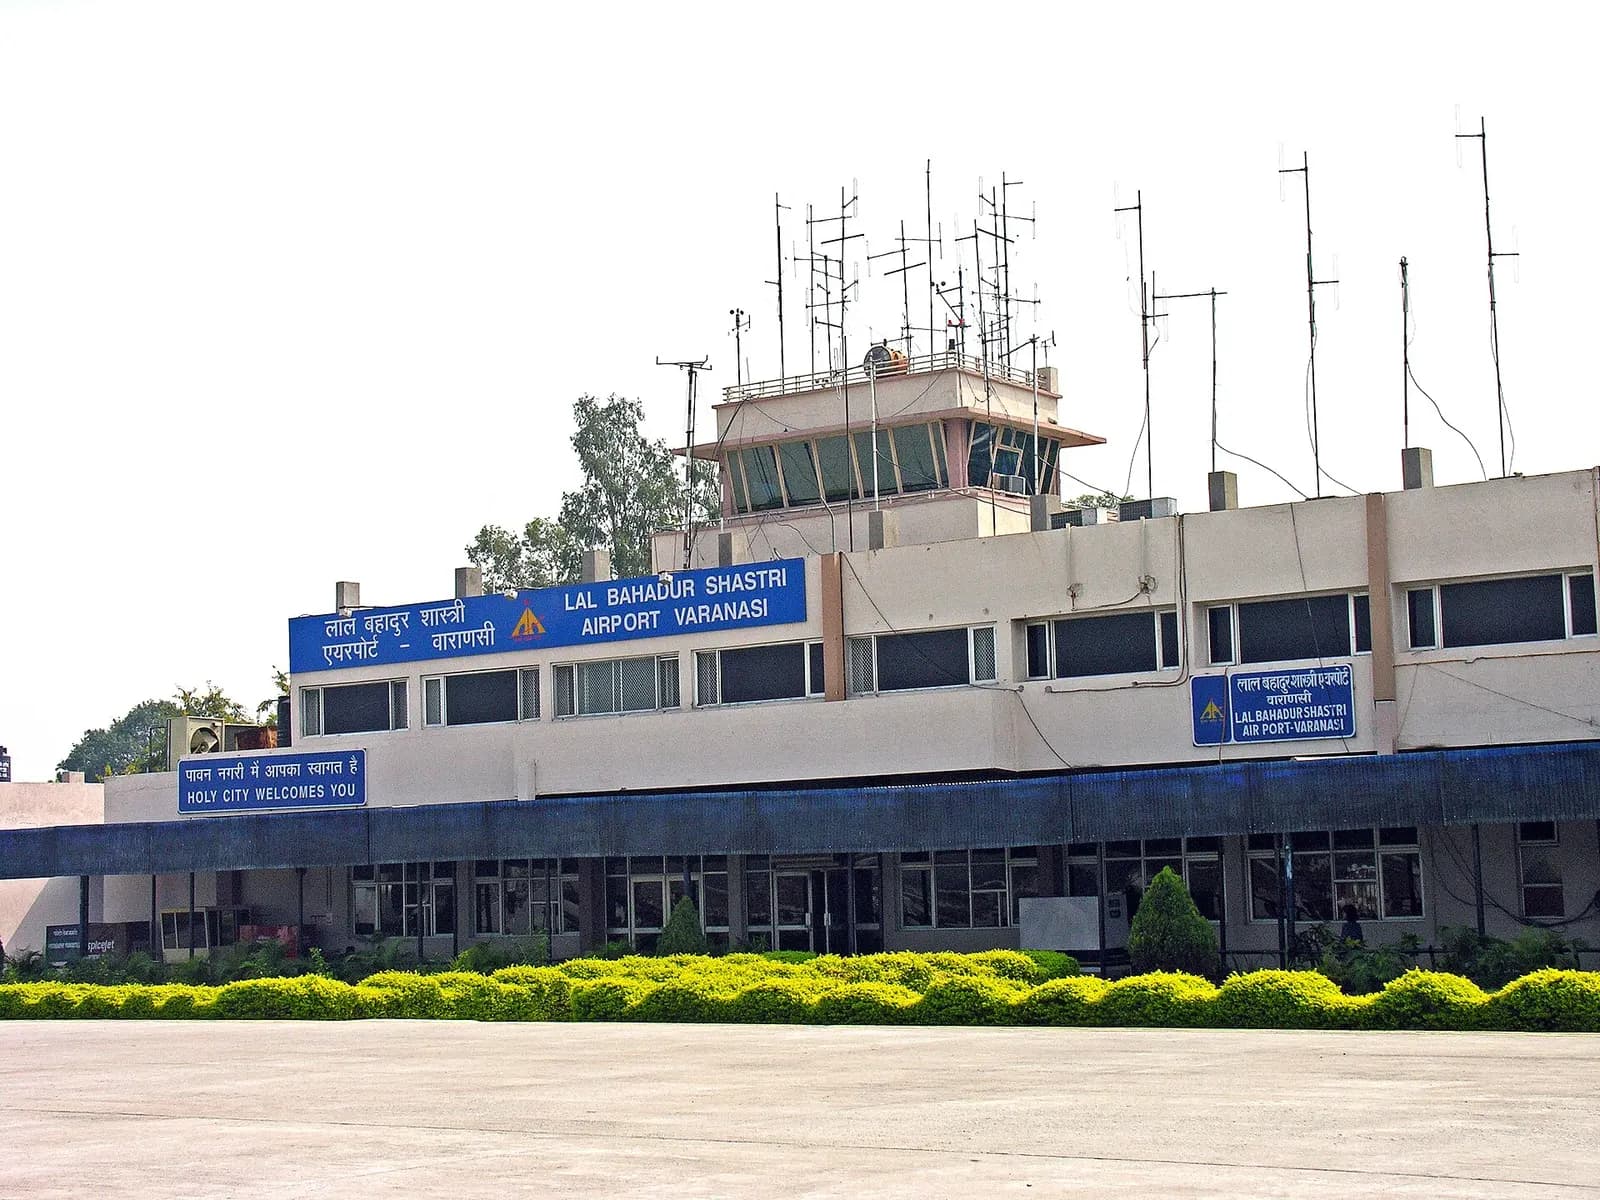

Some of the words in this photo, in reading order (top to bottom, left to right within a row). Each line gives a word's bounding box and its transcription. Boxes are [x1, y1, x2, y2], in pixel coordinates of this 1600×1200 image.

[565, 591, 597, 611] LAL
[607, 579, 695, 606] BAHADUR
[705, 568, 787, 595] SHASTRI
[324, 617, 356, 637] लाल
[364, 611, 410, 636] बहादुर
[420, 599, 466, 626] शास्त्री
[581, 611, 660, 636] AIRPORT
[674, 598, 768, 626] VARANASI
[322, 636, 379, 665] एयरपोर्ट
[432, 621, 496, 651] वाराणसी
[1237, 677, 1261, 693] लाल
[1262, 675, 1292, 693] बहादुर
[1266, 690, 1312, 705] वाराणसी
[1235, 711, 1255, 724] LAL
[1256, 708, 1303, 722] BAHADUR
[1302, 704, 1347, 718] SHASTRI
[1243, 724, 1260, 737] AIR
[185, 768, 211, 782] पावन
[217, 762, 244, 780] नगरी
[250, 760, 260, 778] में
[265, 764, 301, 778] आपका
[307, 760, 343, 776] स्वागत
[349, 755, 358, 775] है
[187, 790, 217, 804] HOLY
[223, 789, 249, 802] CITY
[255, 785, 324, 800] WELCOMES
[330, 783, 355, 797] YOU
